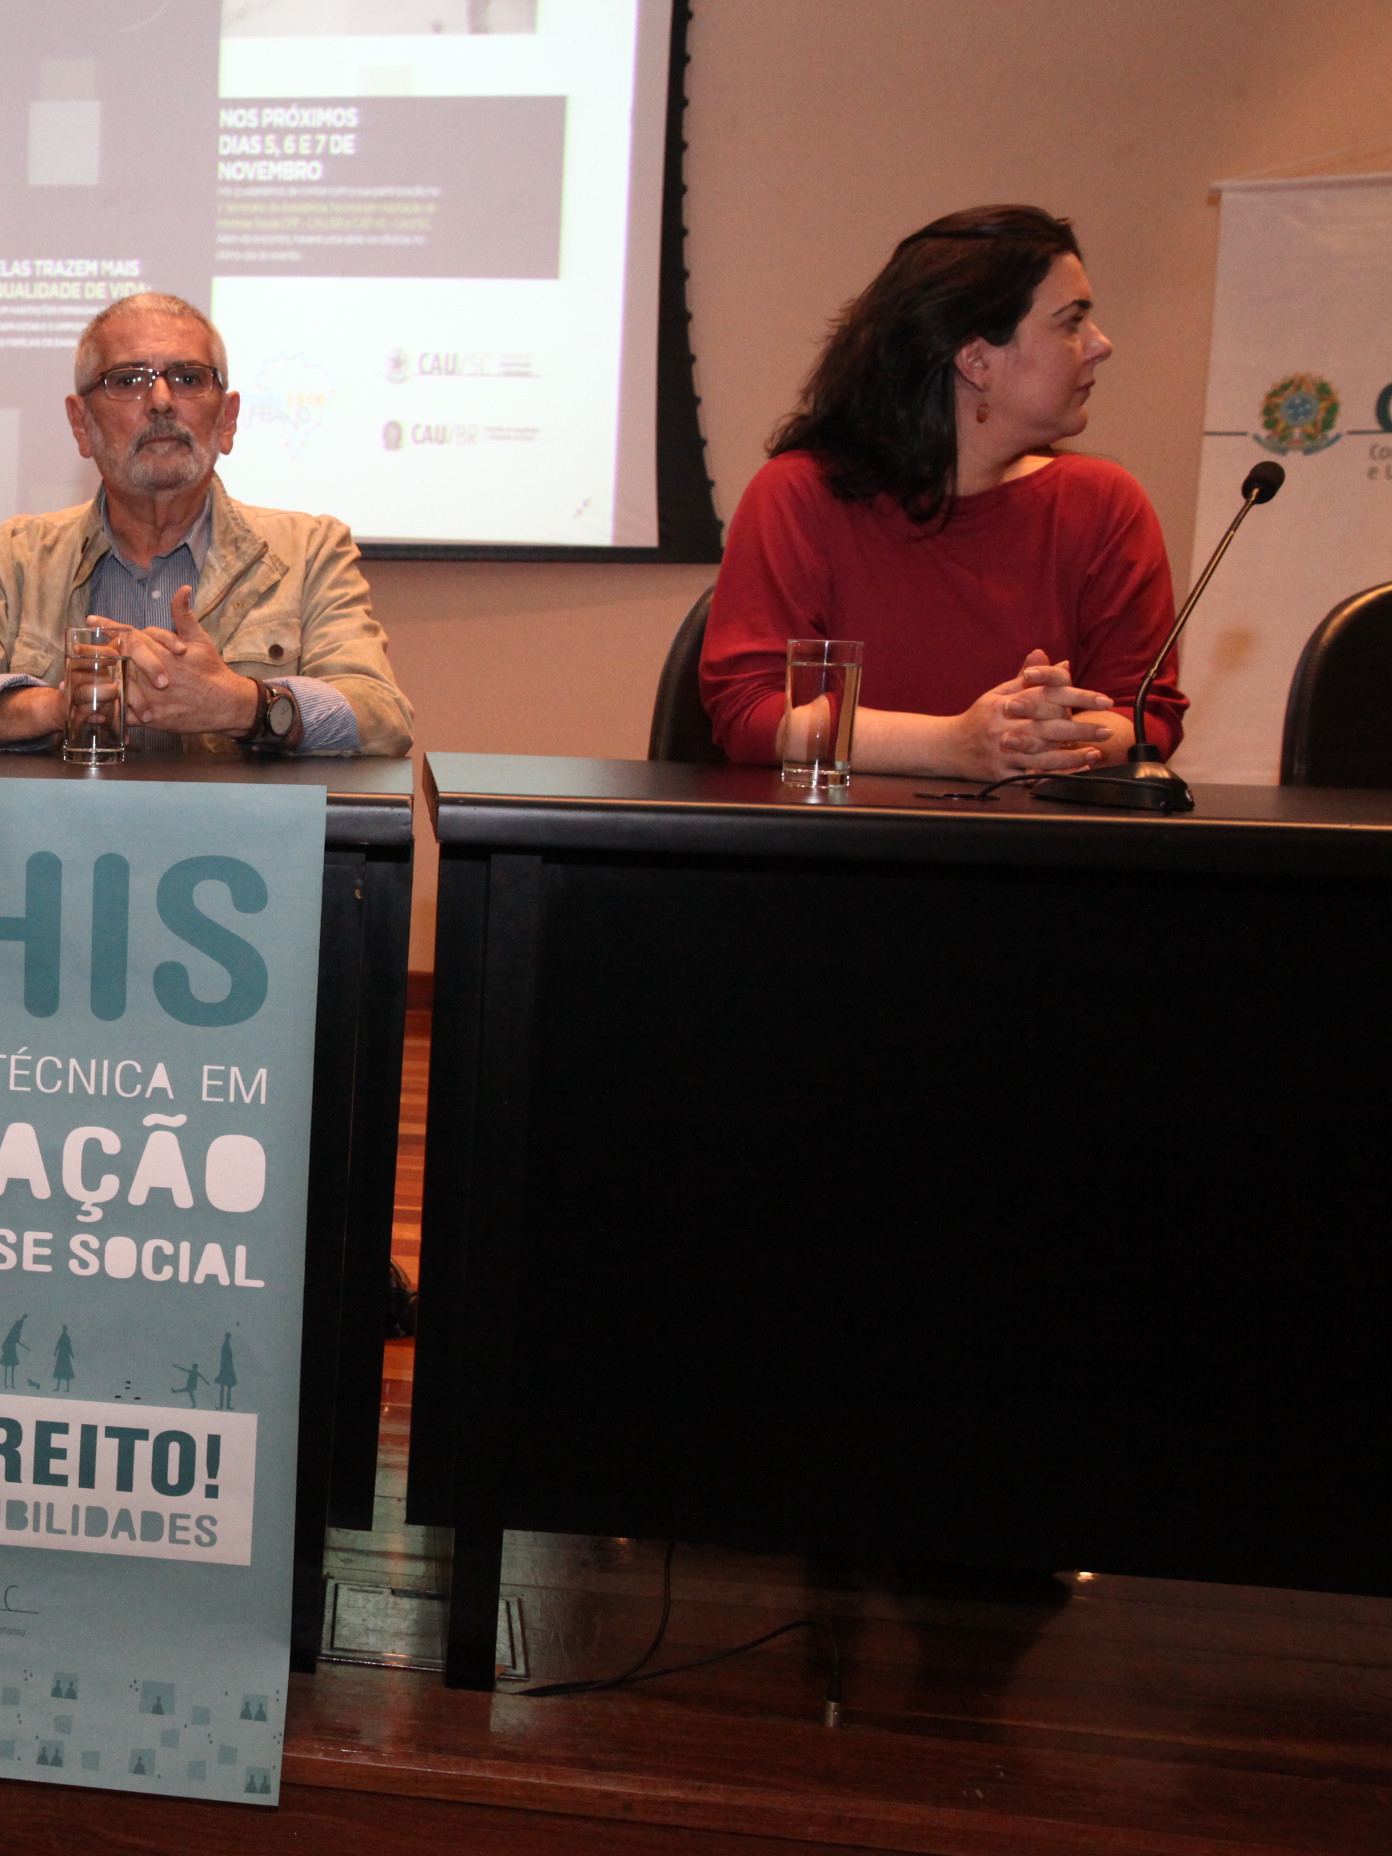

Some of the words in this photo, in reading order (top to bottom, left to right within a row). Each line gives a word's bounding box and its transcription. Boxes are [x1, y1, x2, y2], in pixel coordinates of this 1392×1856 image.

[219, 107, 259, 129] NOS
[261, 103, 358, 128] PRÓXIMOS
[218, 134, 262, 155] DIAS
[264, 133, 281, 157] 5,
[283, 133, 296, 155] 6
[298, 133, 312, 155] E
[315, 133, 327, 155] 7
[329, 133, 356, 155] DE
[217, 160, 323, 181] NOVEMBRO
[33, 259, 98, 277] TRAZEM
[101, 259, 140, 277] MAIS
[84, 281, 108, 299] DE
[411, 423, 478, 445] CAU/BR
[201, 1065, 268, 1104] EM
[68, 1233, 266, 1289] SOCIAL
